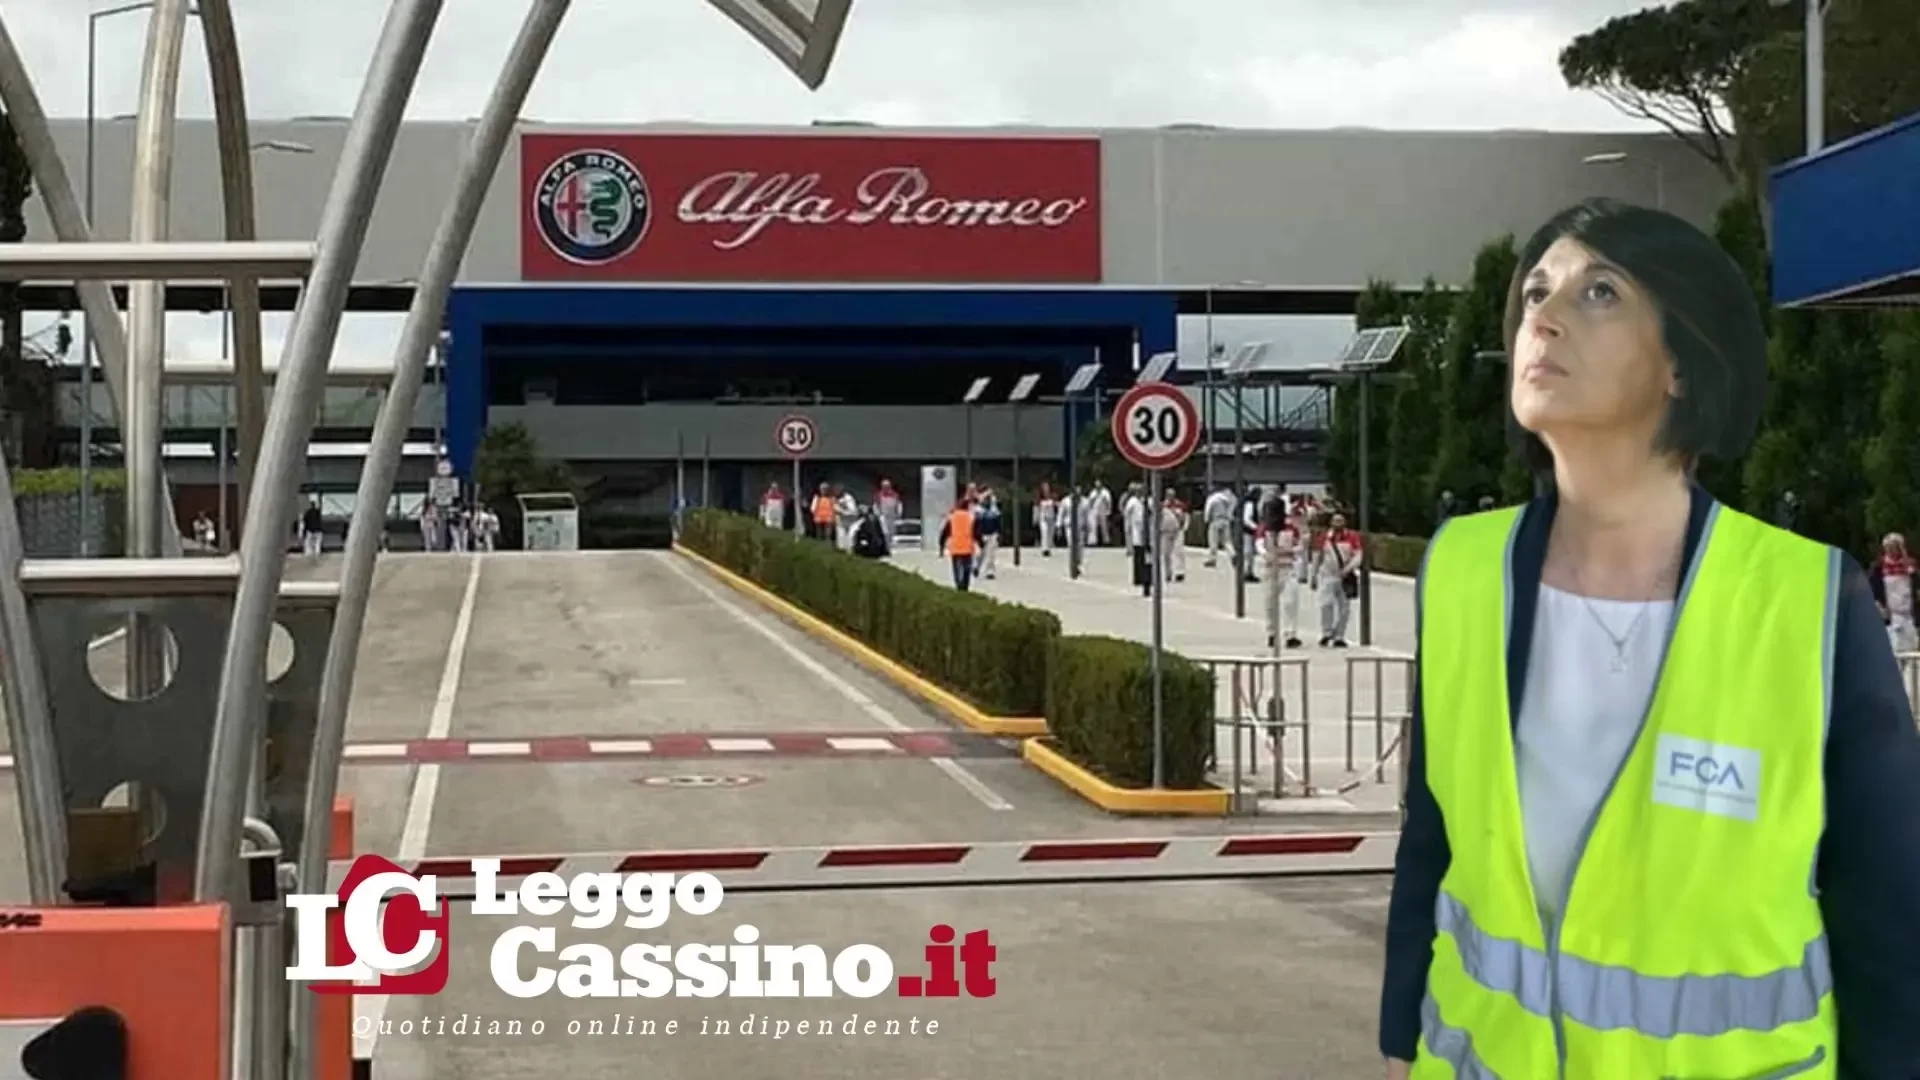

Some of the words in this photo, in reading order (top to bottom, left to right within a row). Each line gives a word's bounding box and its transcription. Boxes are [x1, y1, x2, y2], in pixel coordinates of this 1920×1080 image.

[541, 161, 577, 207] ALFA
[586, 155, 646, 209] ROMEO
[676, 170, 846, 250] Alfa
[846, 166, 1088, 226] Romeo
[786, 427, 807, 446] 30
[1134, 406, 1180, 445] 30
[1669, 750, 1745, 791] FCA
